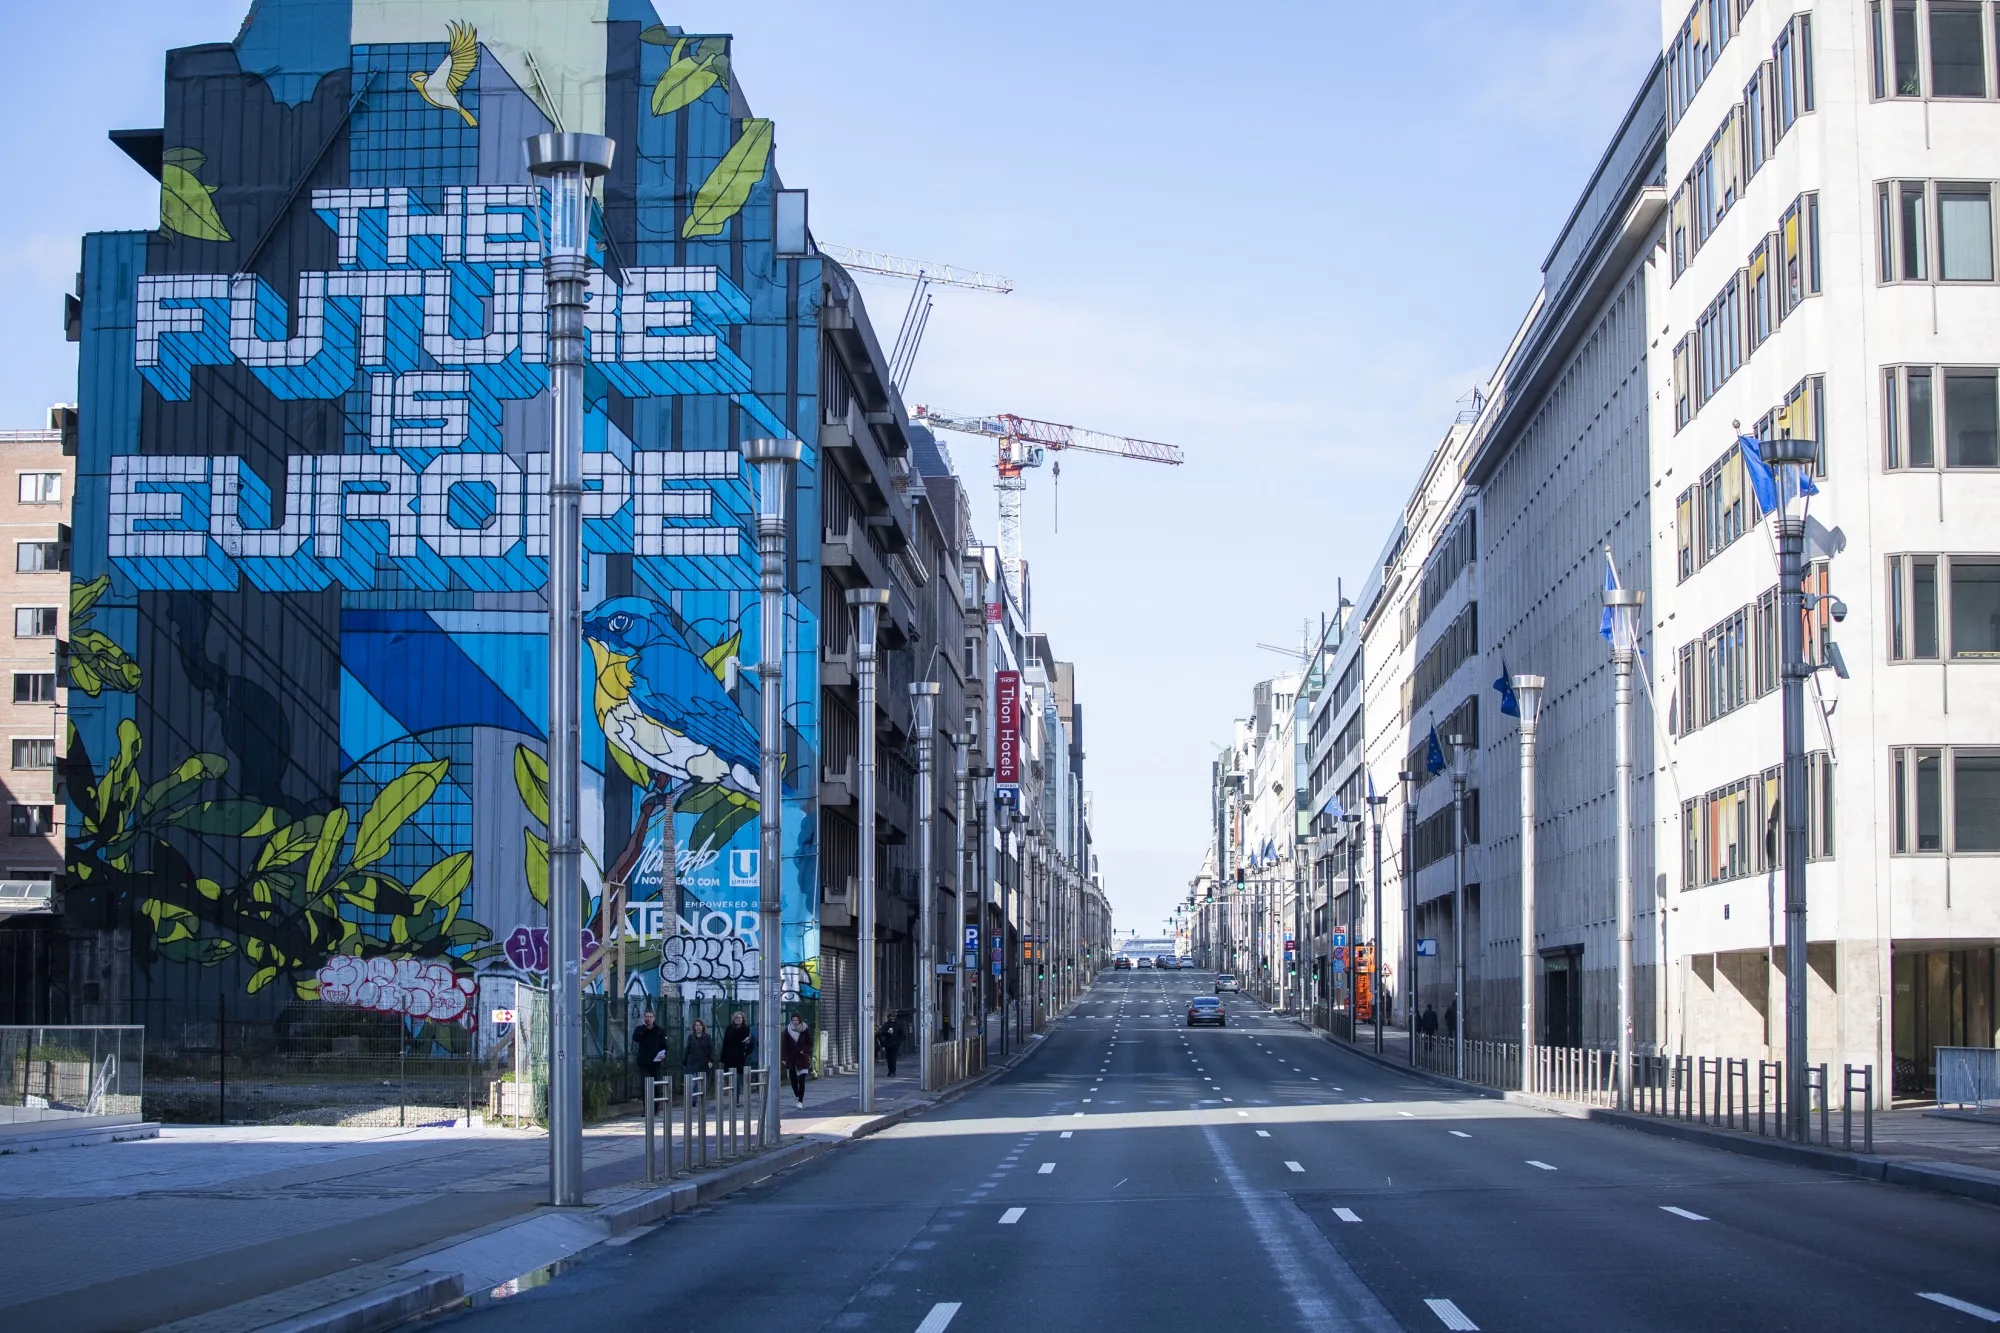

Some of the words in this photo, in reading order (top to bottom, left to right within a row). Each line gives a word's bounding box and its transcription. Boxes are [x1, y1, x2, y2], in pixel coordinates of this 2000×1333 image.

[311, 186, 546, 264] THE
[135, 266, 720, 367] FUTURE
[370, 370, 471, 449] IS
[987, 423, 1005, 433] maes
[107, 450, 742, 558] EUROPE
[1001, 686, 1015, 724] Thon
[1001, 730, 1015, 776] Hotels
[641, 877, 720, 887] NOVEAD.COM
[608, 901, 760, 948] ATENOR
[965, 928, 978, 944] P
